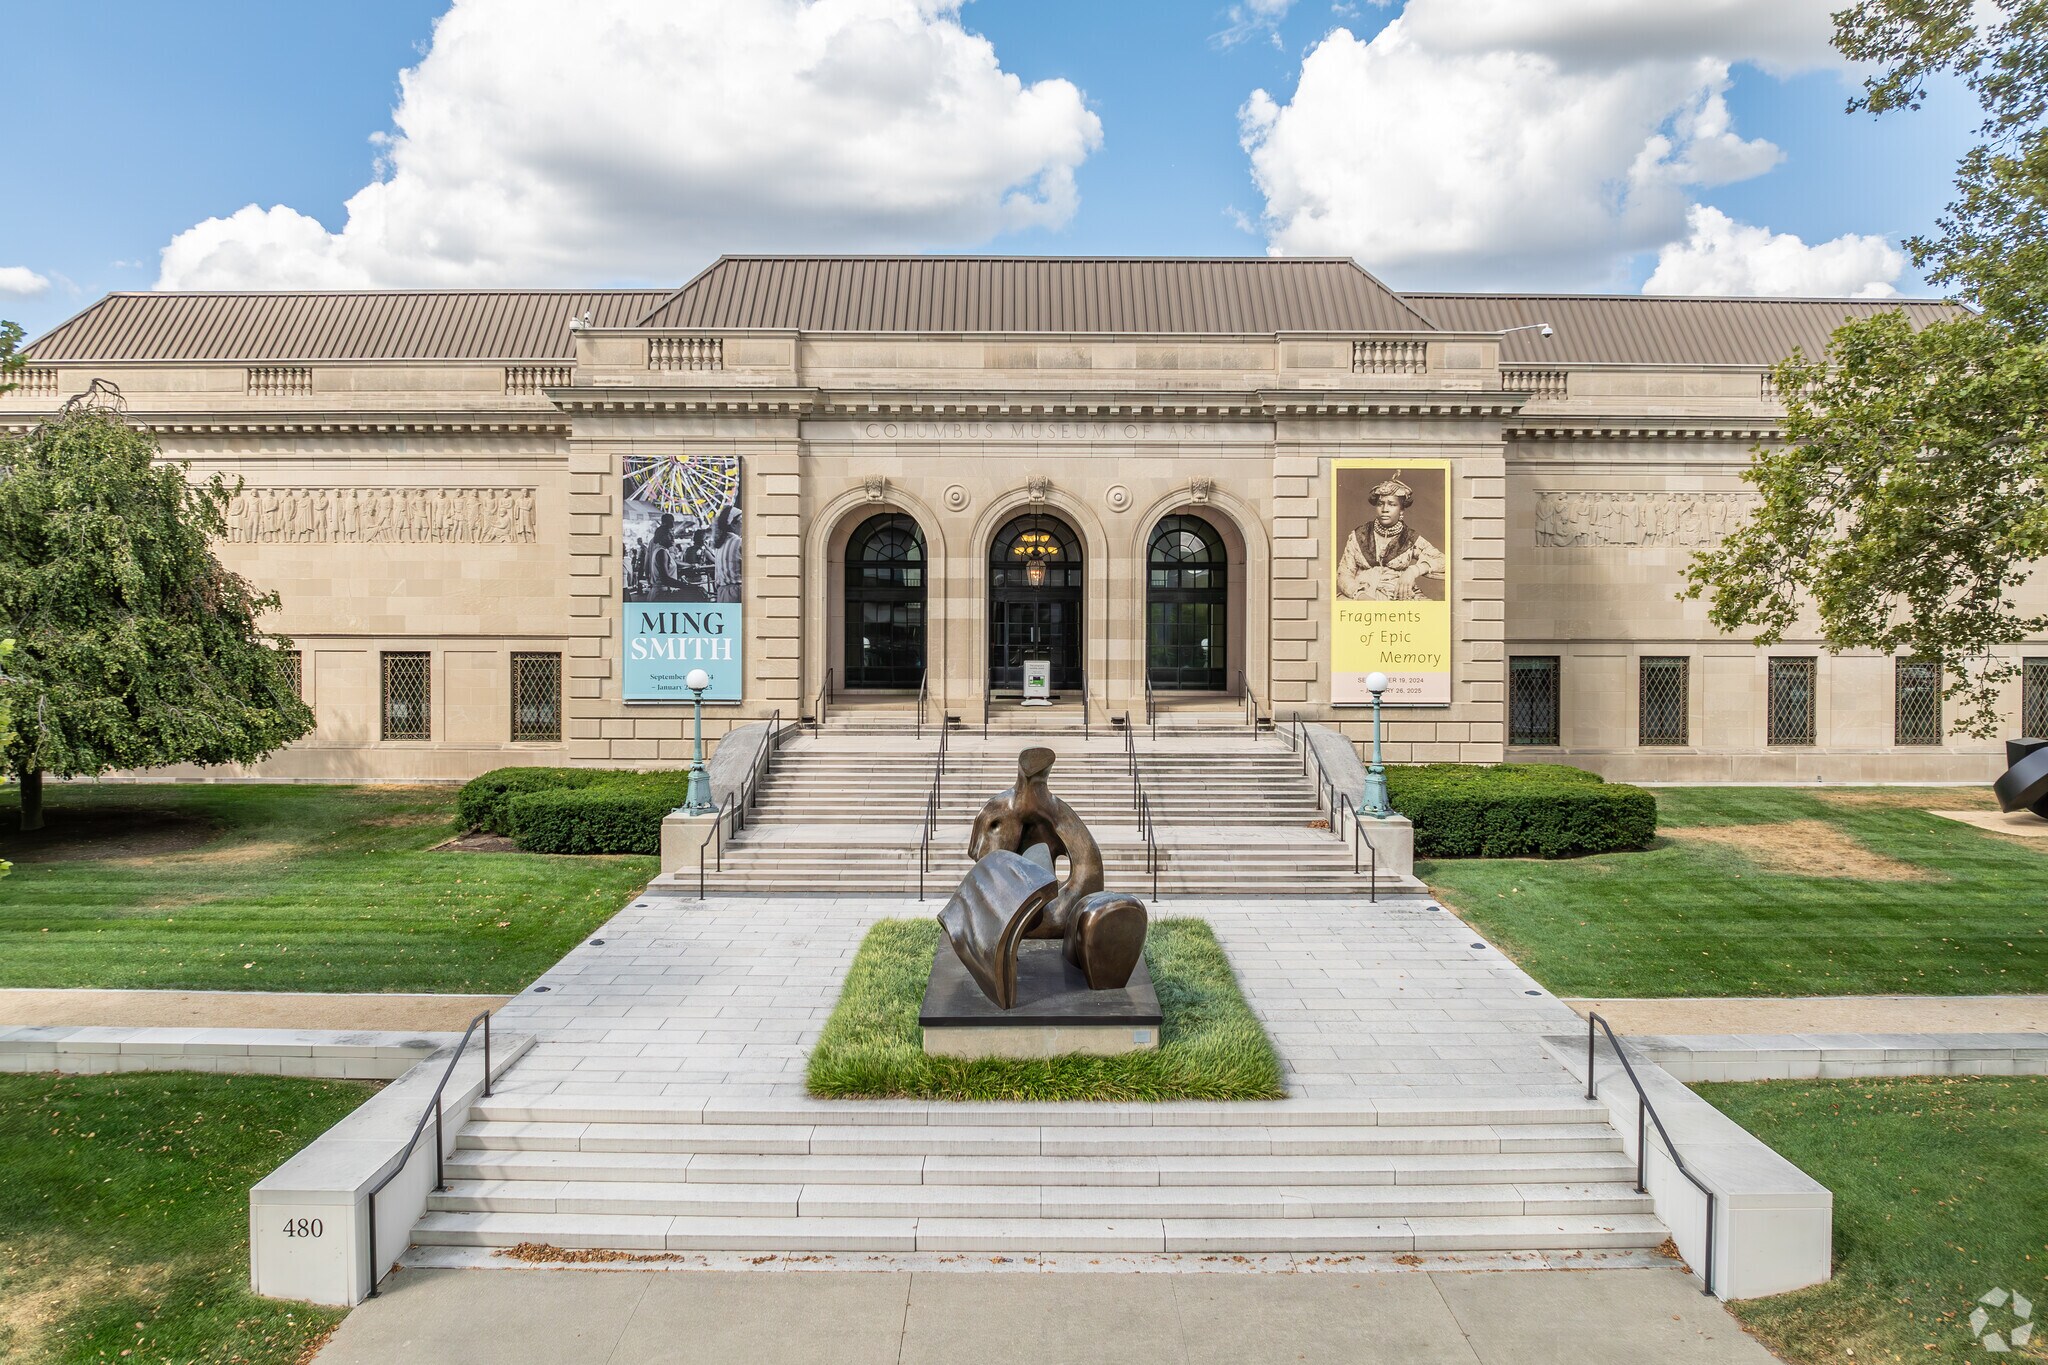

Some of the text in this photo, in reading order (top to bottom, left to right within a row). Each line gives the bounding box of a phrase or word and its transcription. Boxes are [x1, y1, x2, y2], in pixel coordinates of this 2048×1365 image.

[865, 423, 1212, 439] COLUMBUS MUSEUM OF ART
[640, 612, 724, 634] MING
[1340, 609, 1421, 626] Fragments
[1360, 630, 1411, 646] of Epic
[631, 637, 732, 660] SMITH
[1379, 651, 1442, 668] Memory
[282, 1218, 324, 1238] 480
